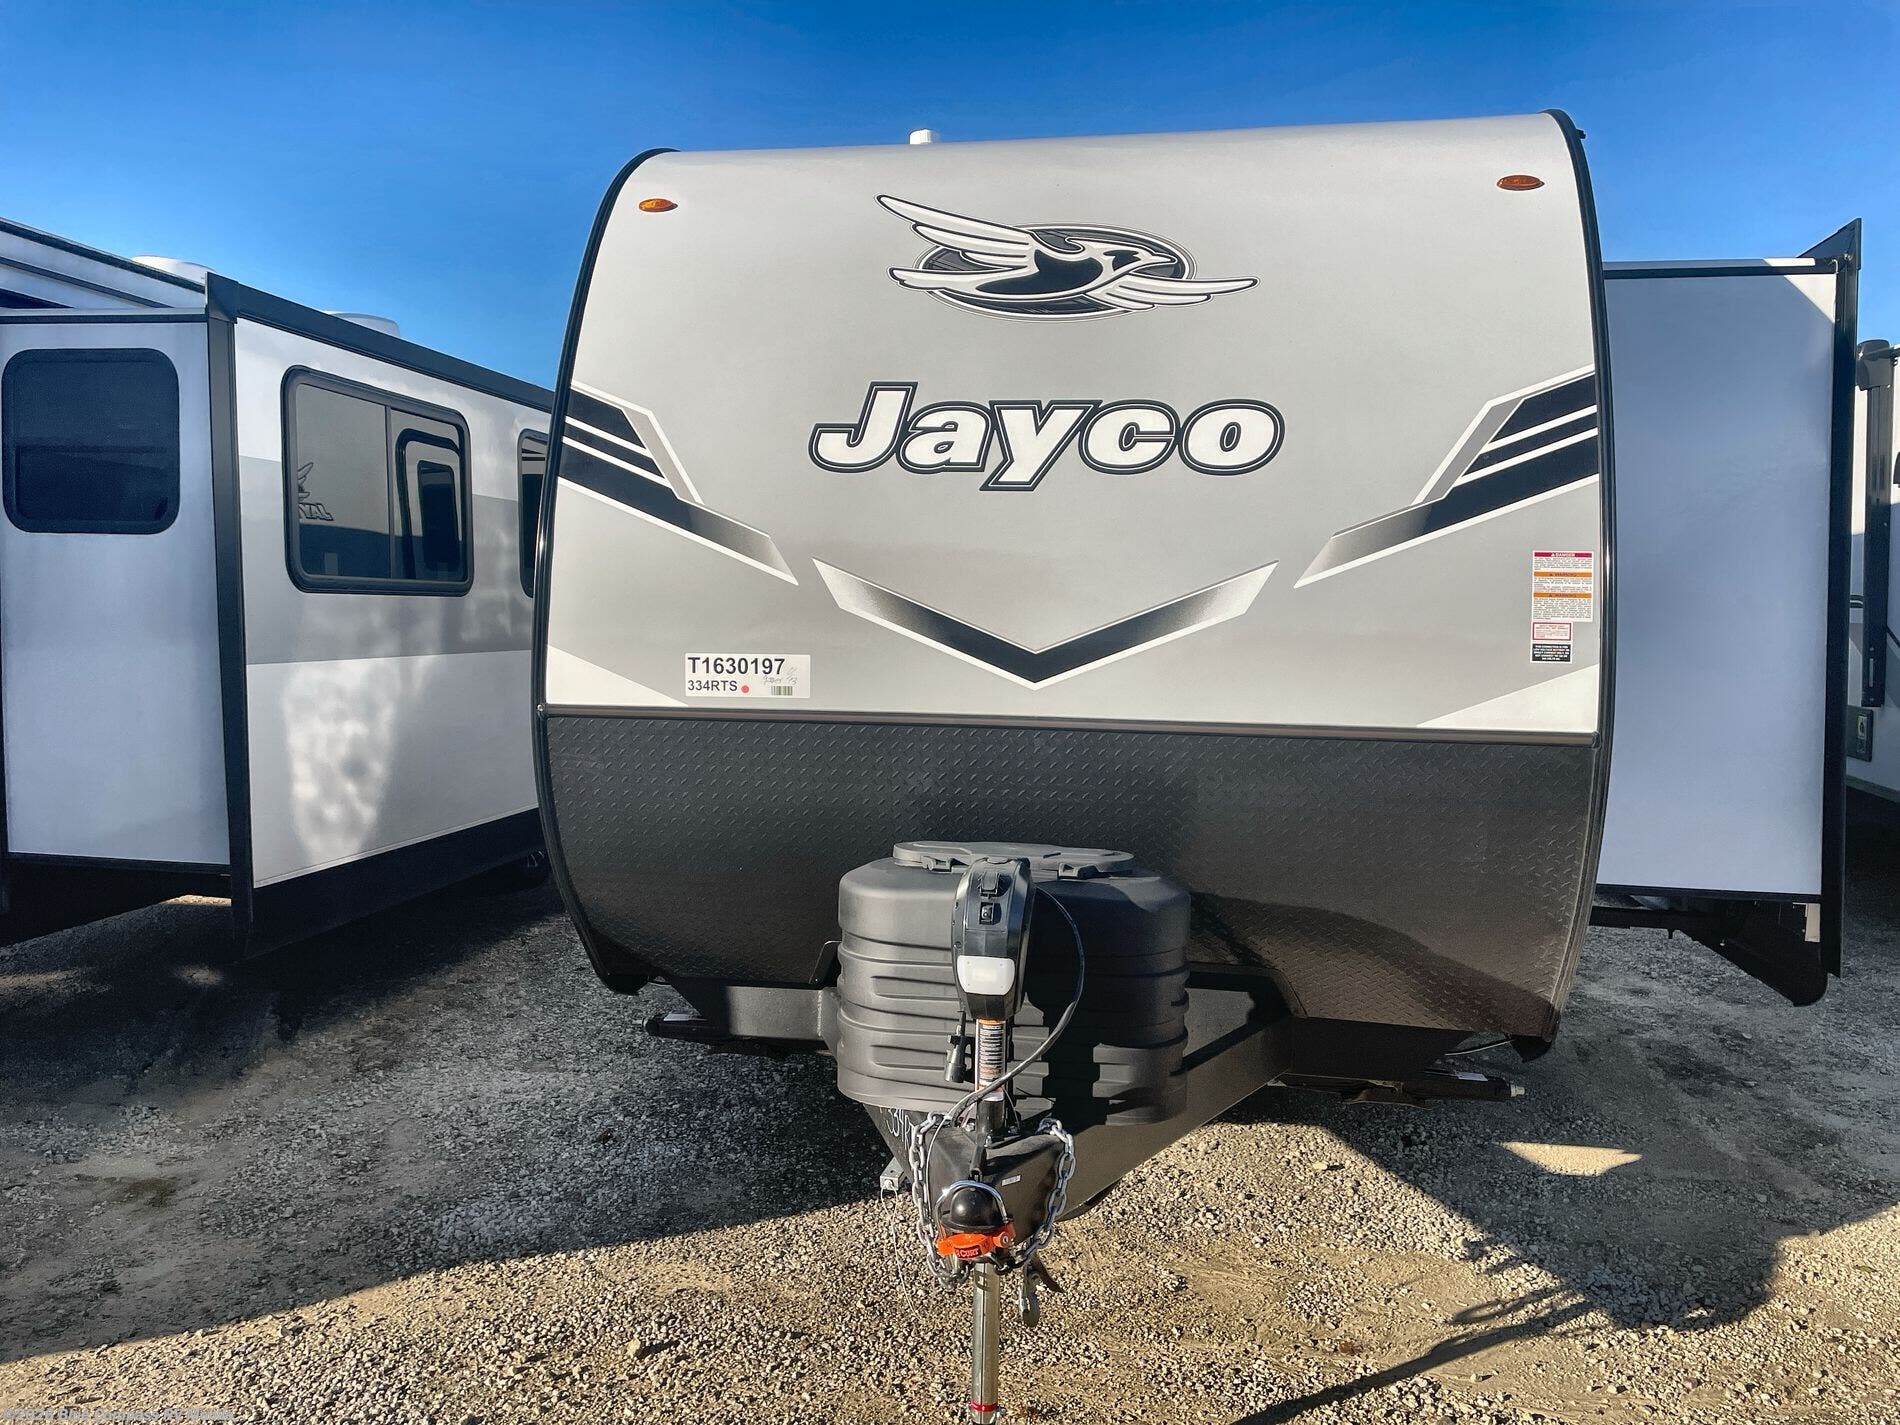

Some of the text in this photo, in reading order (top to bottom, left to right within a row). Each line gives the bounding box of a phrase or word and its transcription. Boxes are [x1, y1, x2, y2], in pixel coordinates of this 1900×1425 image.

[808, 381, 1286, 492] Jayco
[687, 656, 786, 675] T1630197
[687, 680, 738, 692] 334RTS
